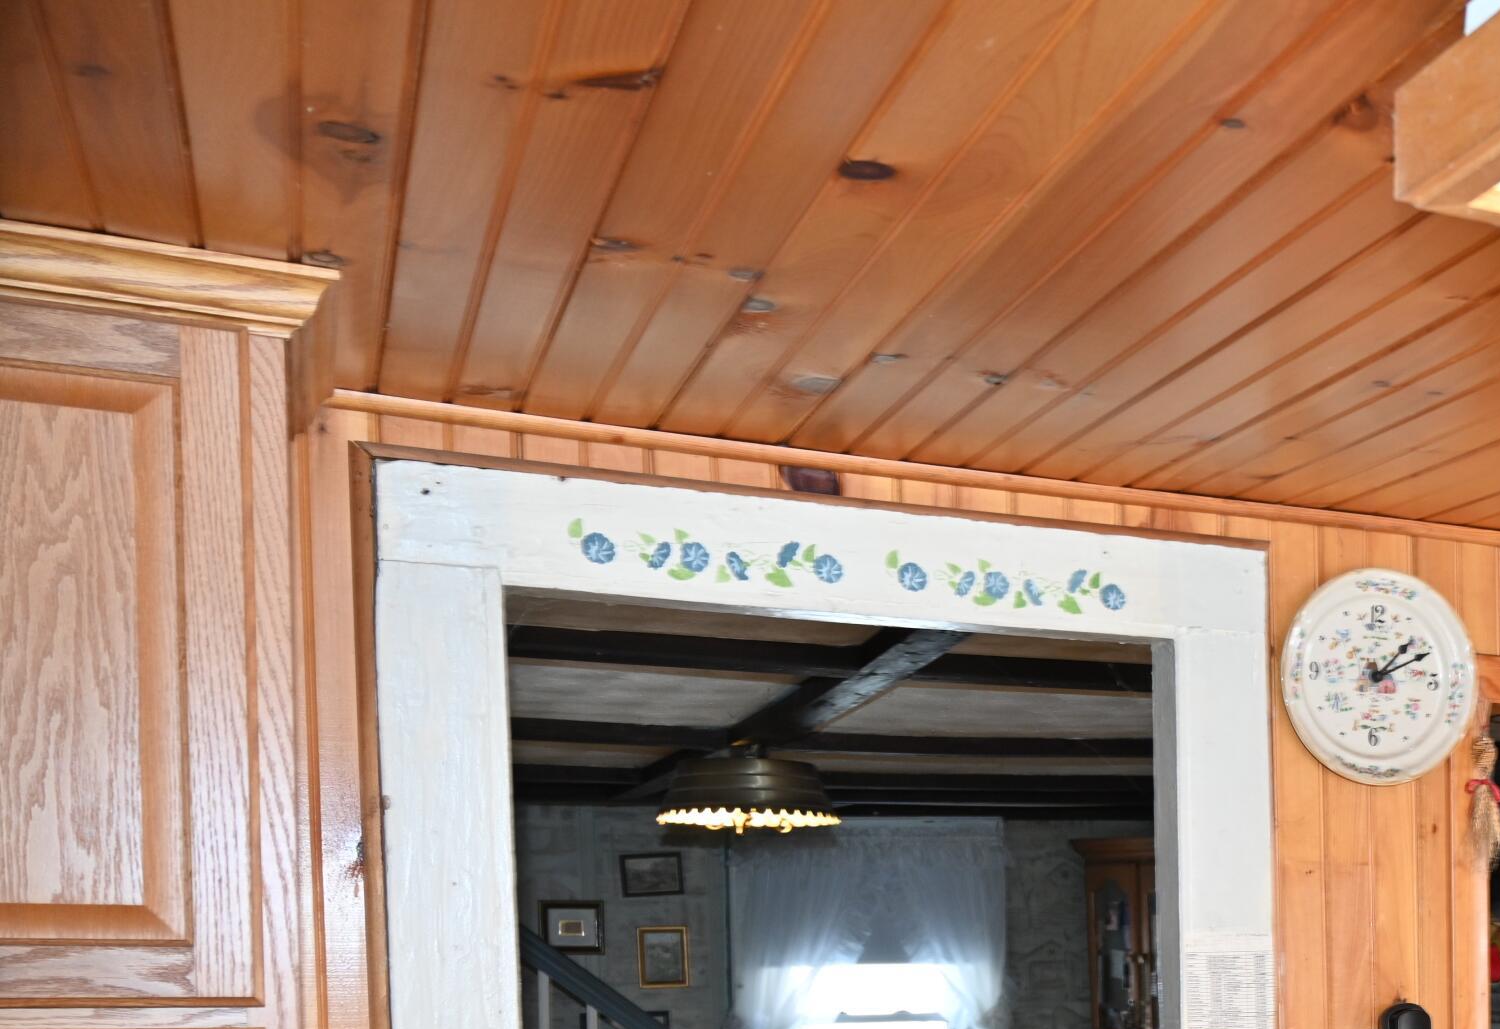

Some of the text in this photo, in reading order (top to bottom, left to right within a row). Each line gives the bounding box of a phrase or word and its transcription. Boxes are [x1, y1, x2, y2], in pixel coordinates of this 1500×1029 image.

[1370, 604, 1385, 623] 12
[1309, 661, 1319, 680] 9
[1426, 672, 1439, 691] 3
[1367, 727, 1379, 747] 6
